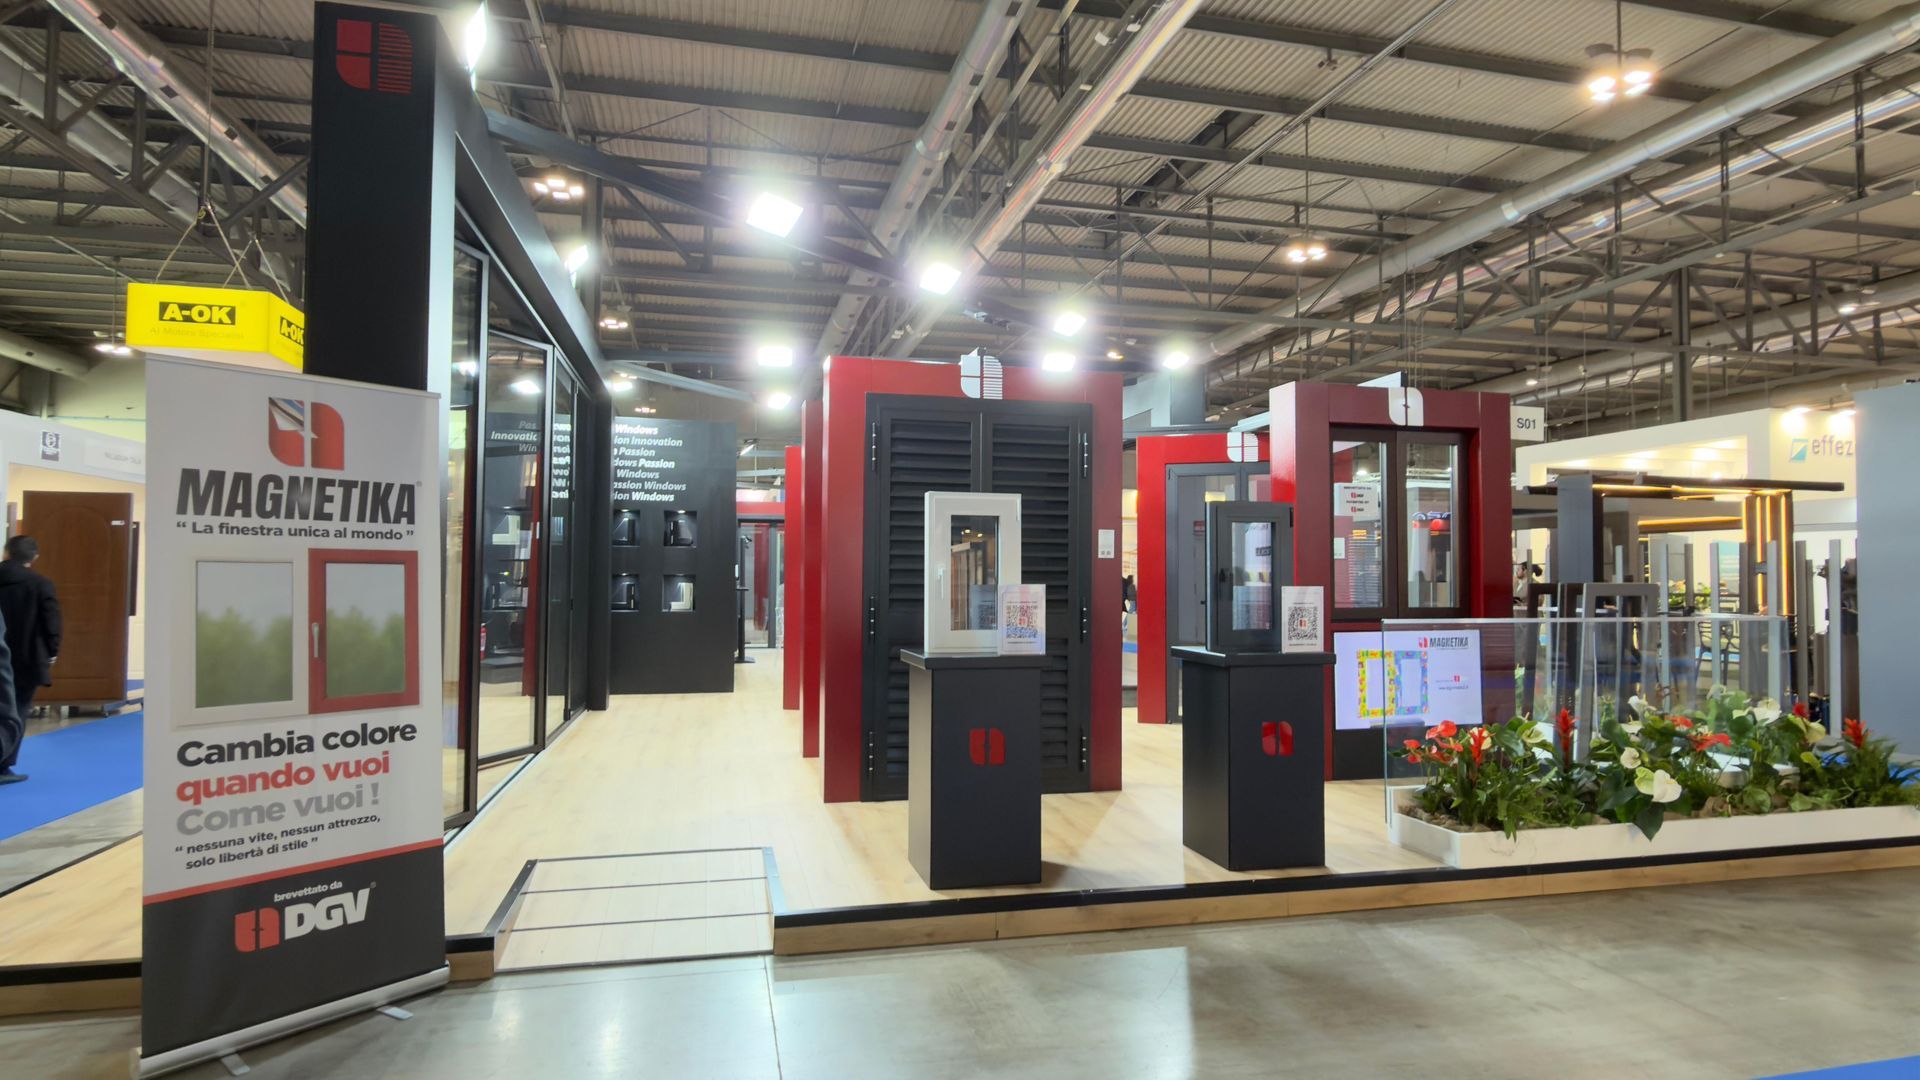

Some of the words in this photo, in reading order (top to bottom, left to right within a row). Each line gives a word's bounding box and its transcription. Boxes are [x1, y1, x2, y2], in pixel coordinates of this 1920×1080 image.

[162, 303, 232, 324] A-OK
[615, 424, 658, 435] Windows
[1516, 417, 1536, 430] S01
[631, 436, 683, 447] Innovation
[619, 447, 656, 457] Passion
[638, 458, 675, 469] Passion
[616, 469, 660, 479] Windows
[644, 480, 687, 491] Windows
[176, 468, 415, 525] MAGNETIKA
[631, 491, 675, 502] Windows
[219, 522, 283, 537] finestra
[288, 525, 330, 539] unica
[334, 527, 348, 539] al
[176, 730, 315, 767] Cambia
[322, 723, 417, 751] colore
[176, 762, 316, 806] quando
[322, 750, 390, 782] vuoi
[176, 801, 286, 836] Come
[293, 784, 364, 817] vuoi
[248, 832, 278, 844] vite,
[280, 823, 325, 838] nessun
[327, 813, 381, 830] attrezzo,
[185, 854, 216, 870] solo
[219, 845, 264, 864] libertà
[266, 842, 279, 855] di
[273, 884, 328, 903] brevettato
[329, 880, 343, 890] da
[284, 888, 371, 940] DGV
